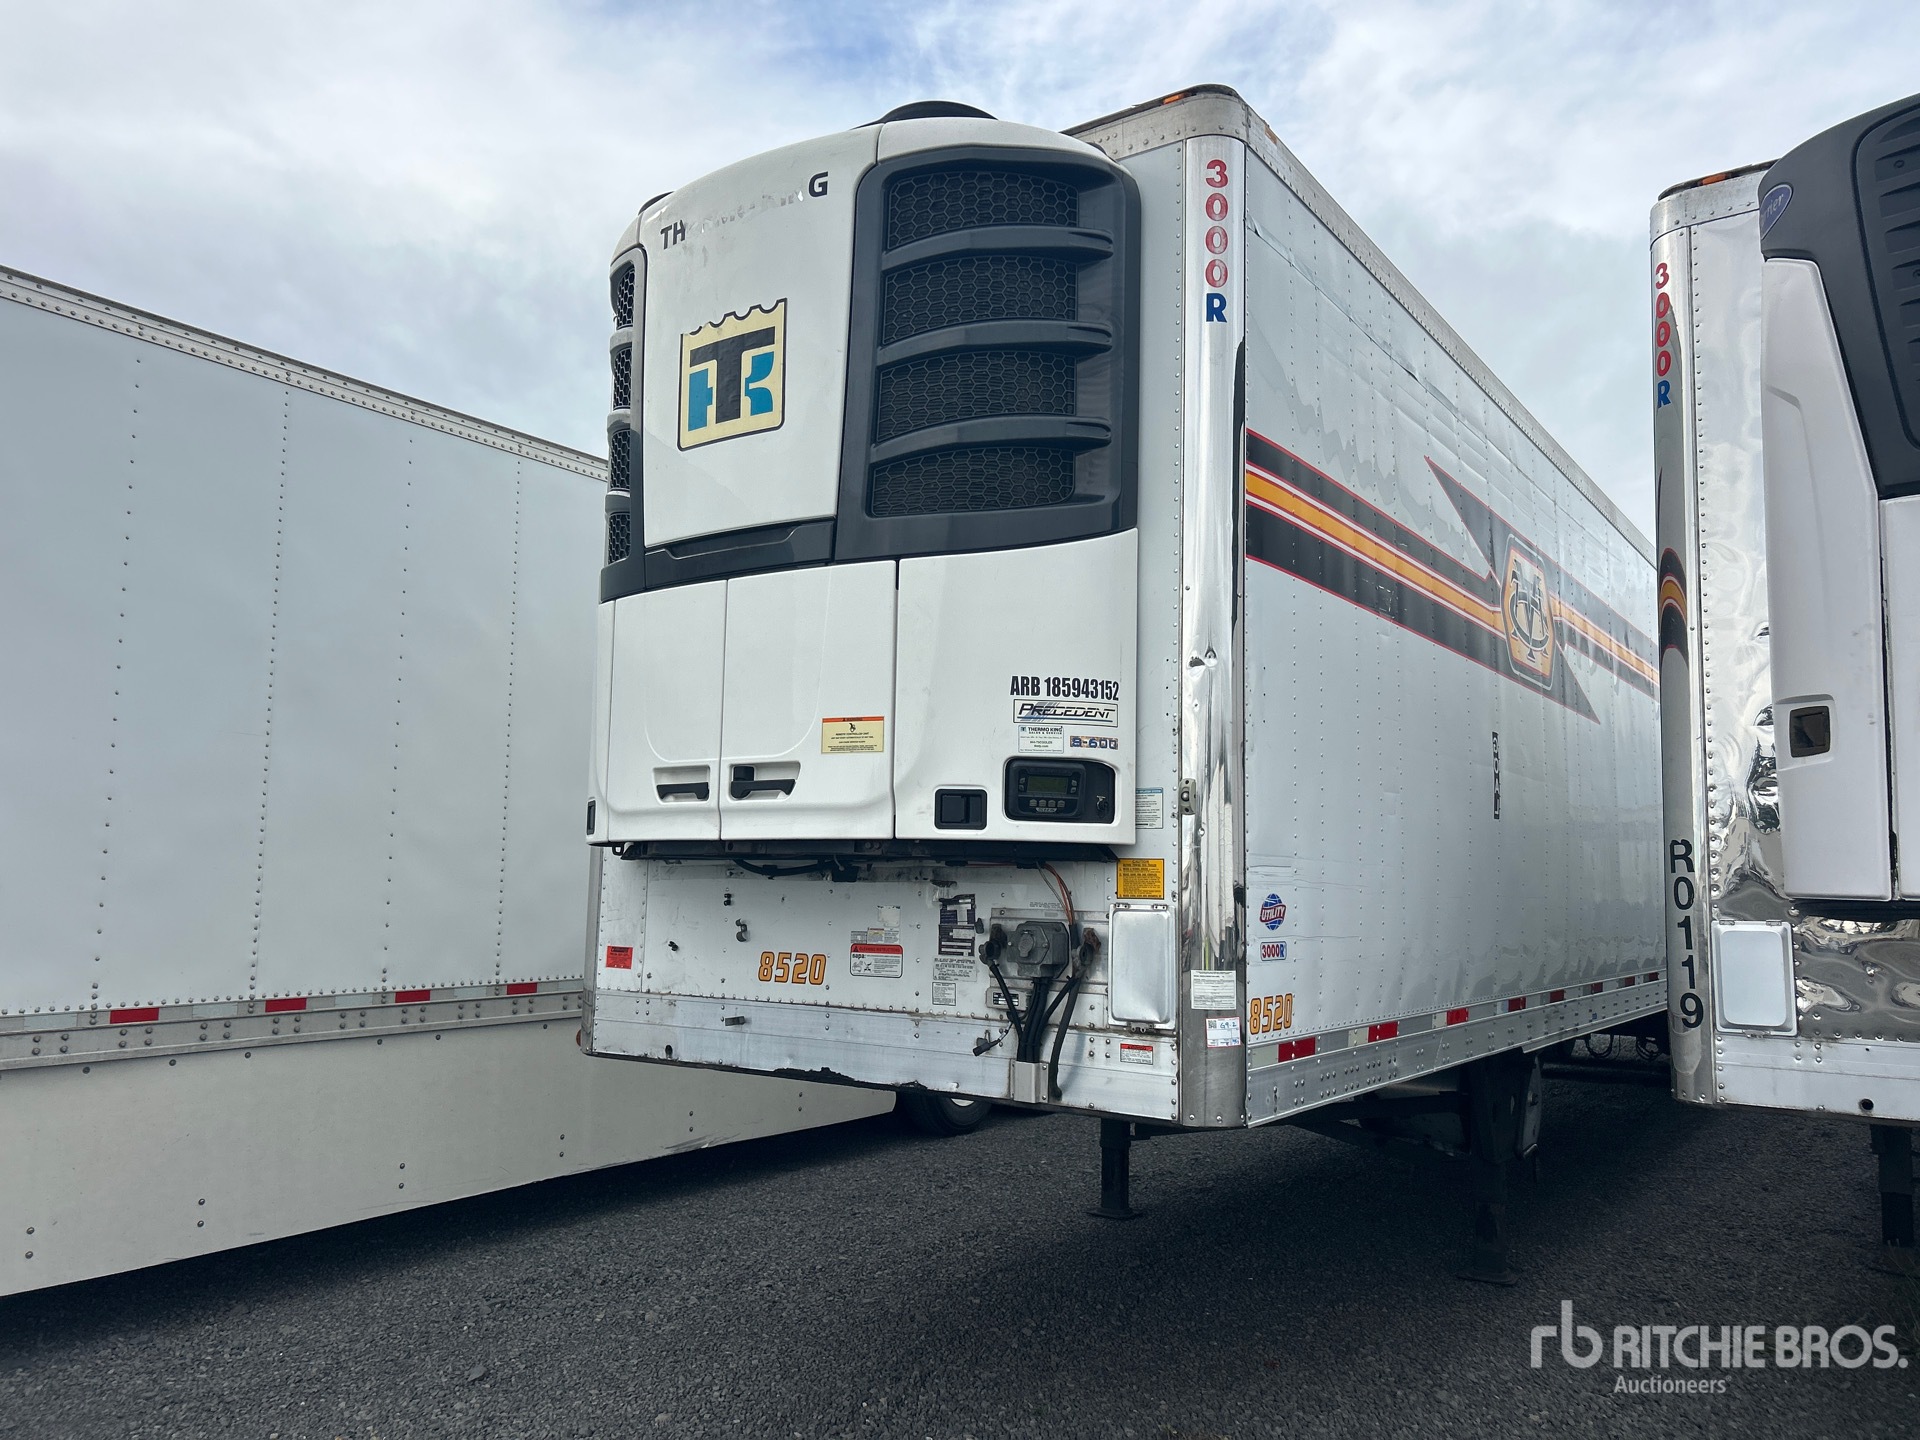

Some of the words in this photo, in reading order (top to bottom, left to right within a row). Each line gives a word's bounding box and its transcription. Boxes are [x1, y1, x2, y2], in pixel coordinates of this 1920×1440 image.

[1205, 159, 1229, 323] 3000R
[1655, 262, 1671, 408] 3000R
[1010, 676, 1041, 696] ARB
[1044, 676, 1119, 701] 185943152
[1261, 906, 1286, 921] UTILITY
[757, 950, 827, 985] 8520
[1262, 943, 1285, 959] 3000R
[1249, 992, 1293, 1035] 8520
